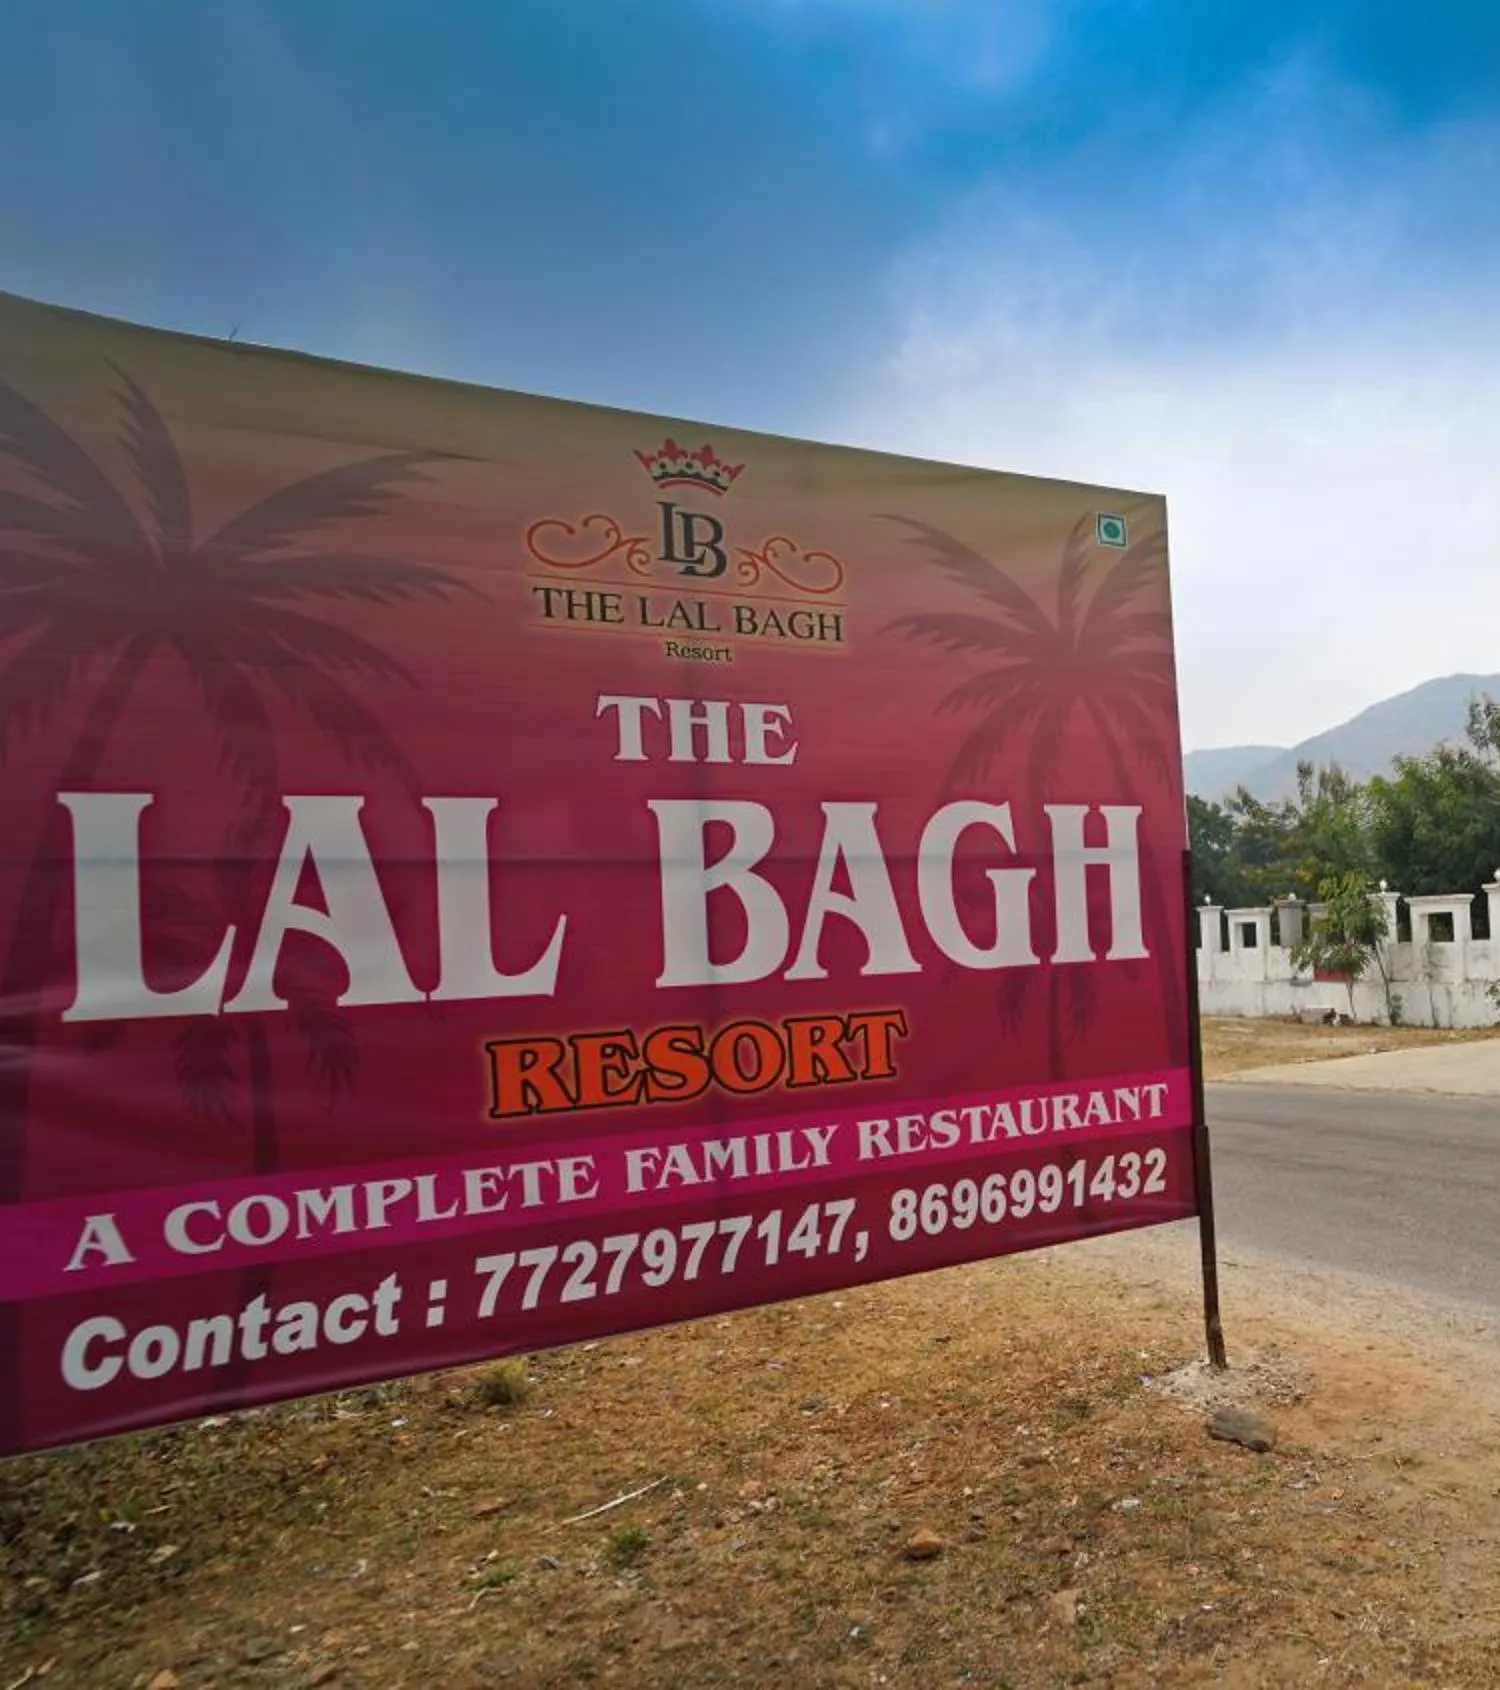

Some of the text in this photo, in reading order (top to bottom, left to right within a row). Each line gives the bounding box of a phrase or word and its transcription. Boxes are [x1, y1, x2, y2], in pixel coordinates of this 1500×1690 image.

[656, 501, 727, 578] LB
[533, 586, 844, 642] THE LAL BAGH
[665, 640, 733, 662] Resort
[596, 694, 799, 766] THE
[57, 792, 1150, 1022] LAL BAGH
[486, 1010, 907, 1118] RESORT
[62, 1083, 1169, 1273] A COMPLETE FAMILY RESTAURANT
[60, 1272, 401, 1391] Contact
[474, 1197, 870, 1320] 7727977147,
[889, 1147, 1168, 1242] 8696991432
